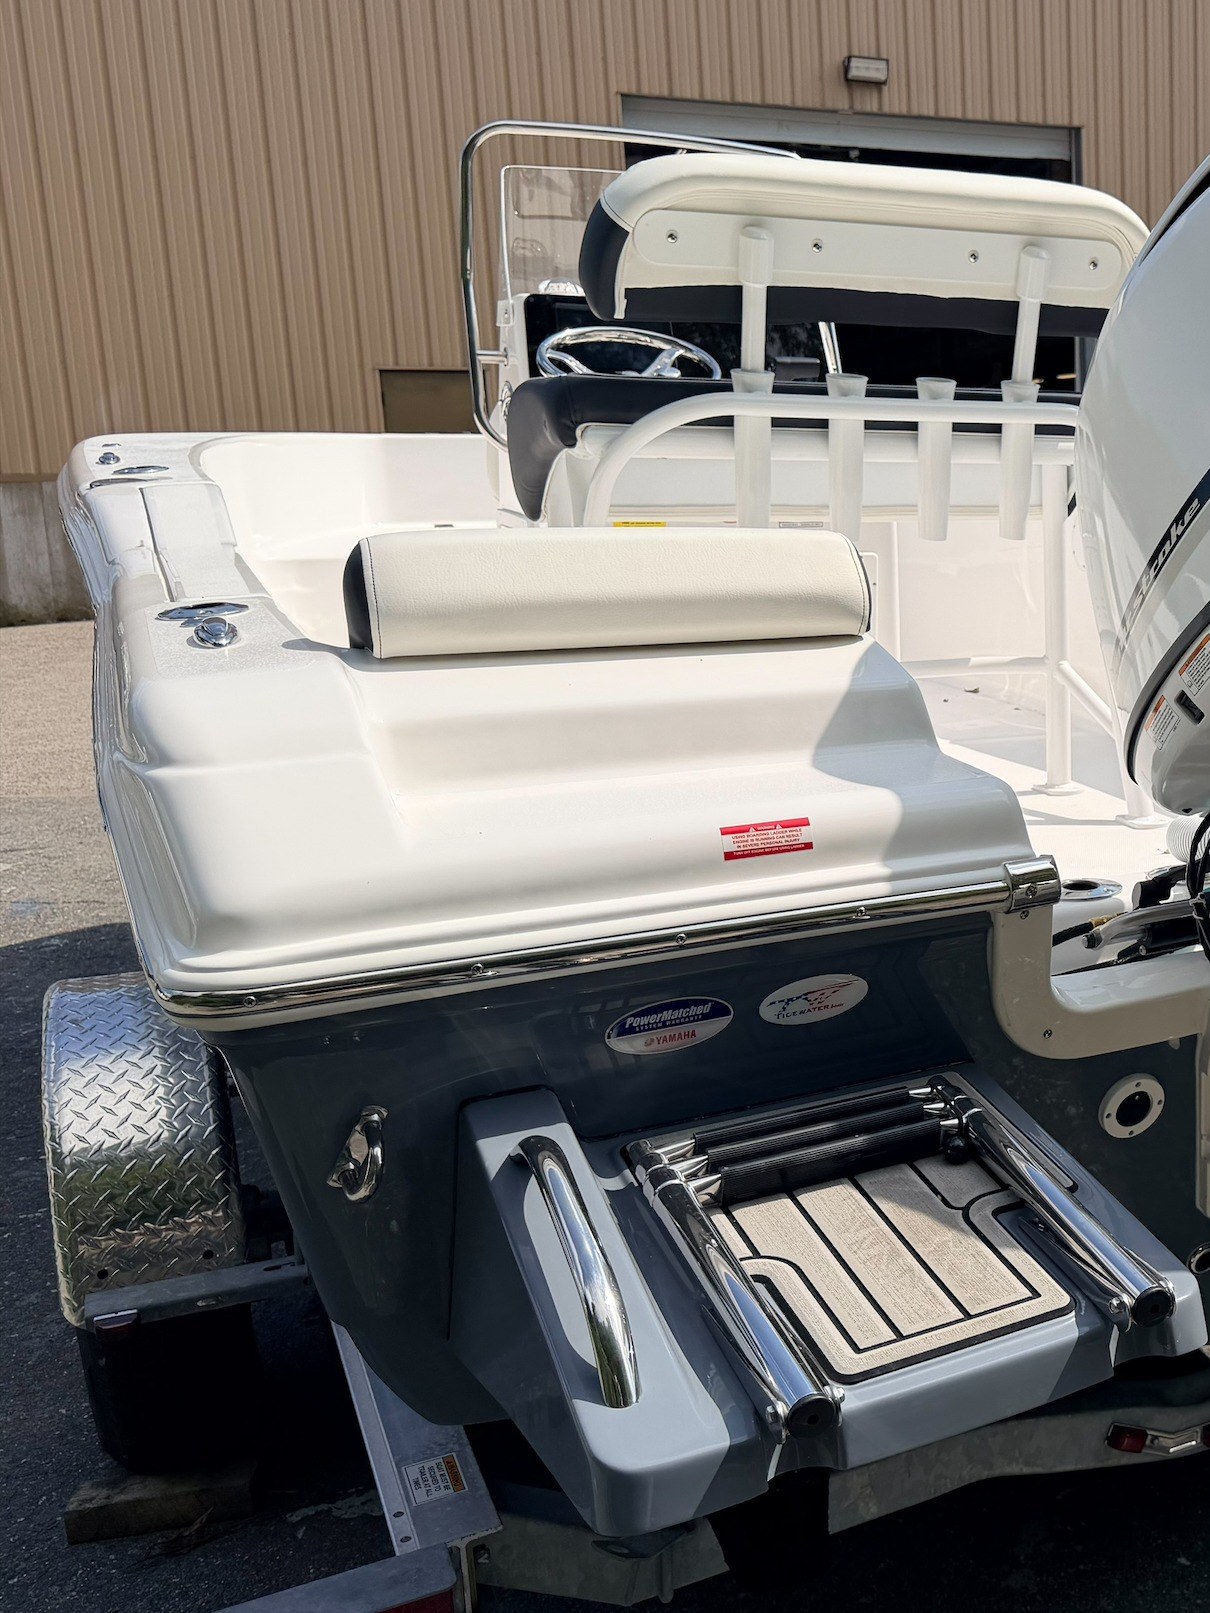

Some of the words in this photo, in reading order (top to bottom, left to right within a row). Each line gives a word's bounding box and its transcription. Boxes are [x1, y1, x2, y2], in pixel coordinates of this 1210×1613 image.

[625, 1002, 712, 1028] PowerMatched
[636, 1022, 662, 1032] SYSTEM
[666, 1015, 702, 1026] WARRANTY
[656, 1029, 697, 1045] YAMAHA
